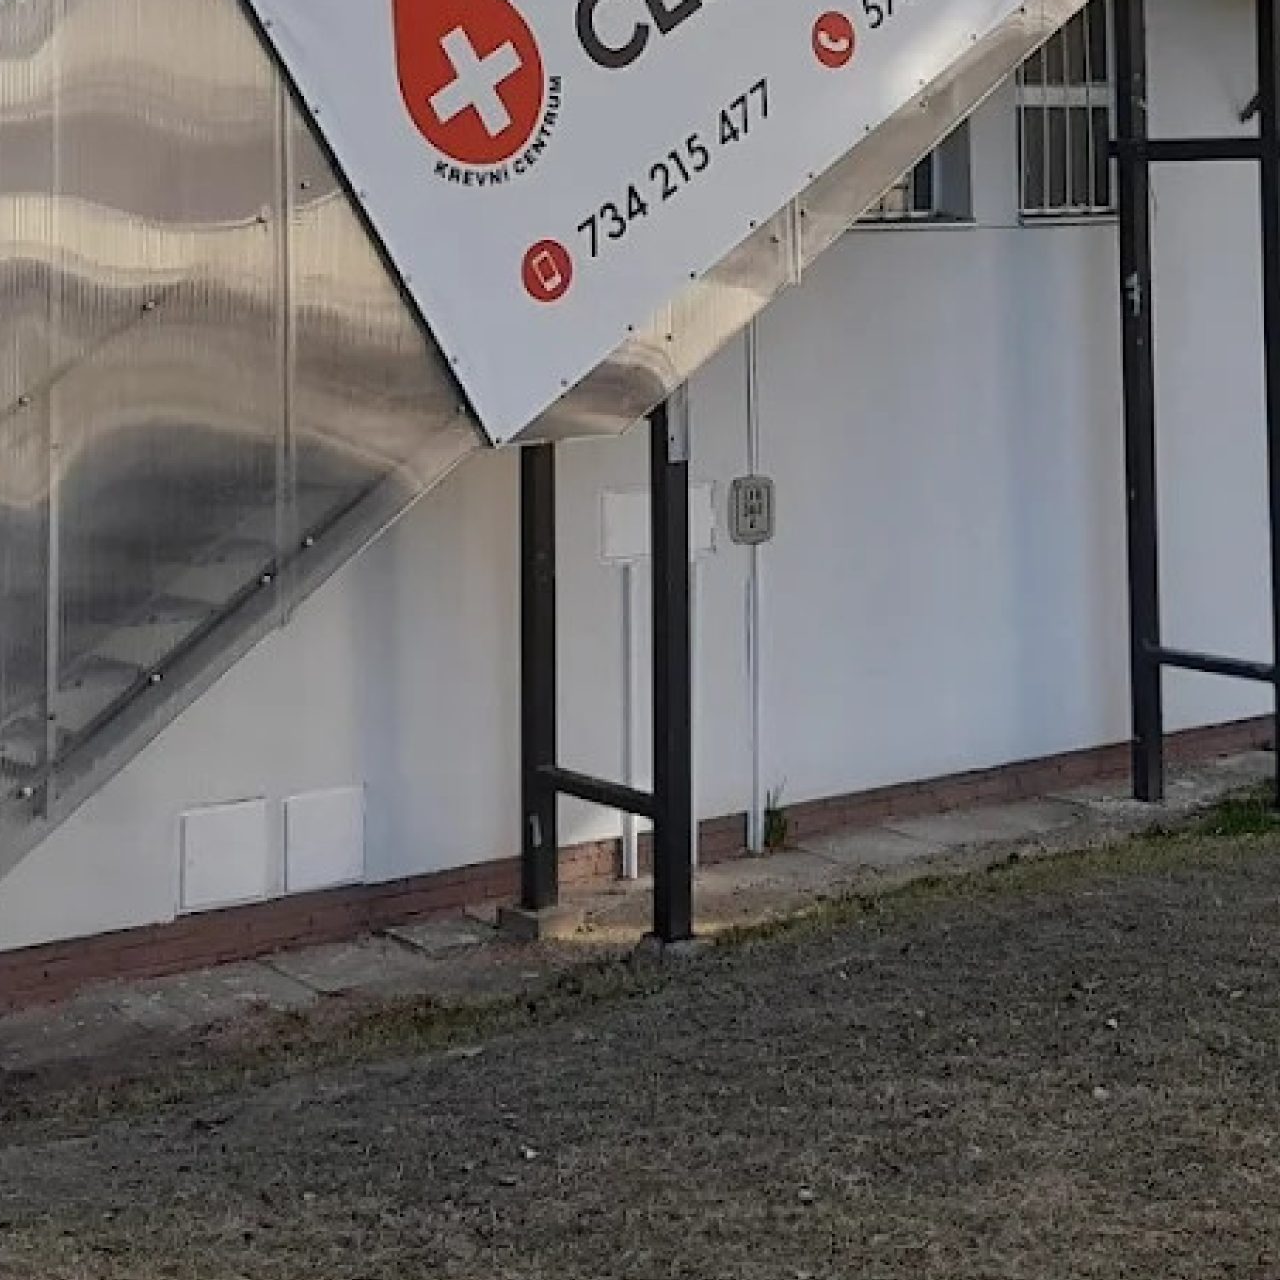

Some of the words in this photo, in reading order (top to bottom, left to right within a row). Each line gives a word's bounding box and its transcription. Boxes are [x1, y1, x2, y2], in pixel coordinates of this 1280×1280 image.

[513, 75, 562, 176] CENTRUM
[577, 183, 649, 258] 734
[649, 132, 709, 202] 215
[718, 78, 768, 145] 477
